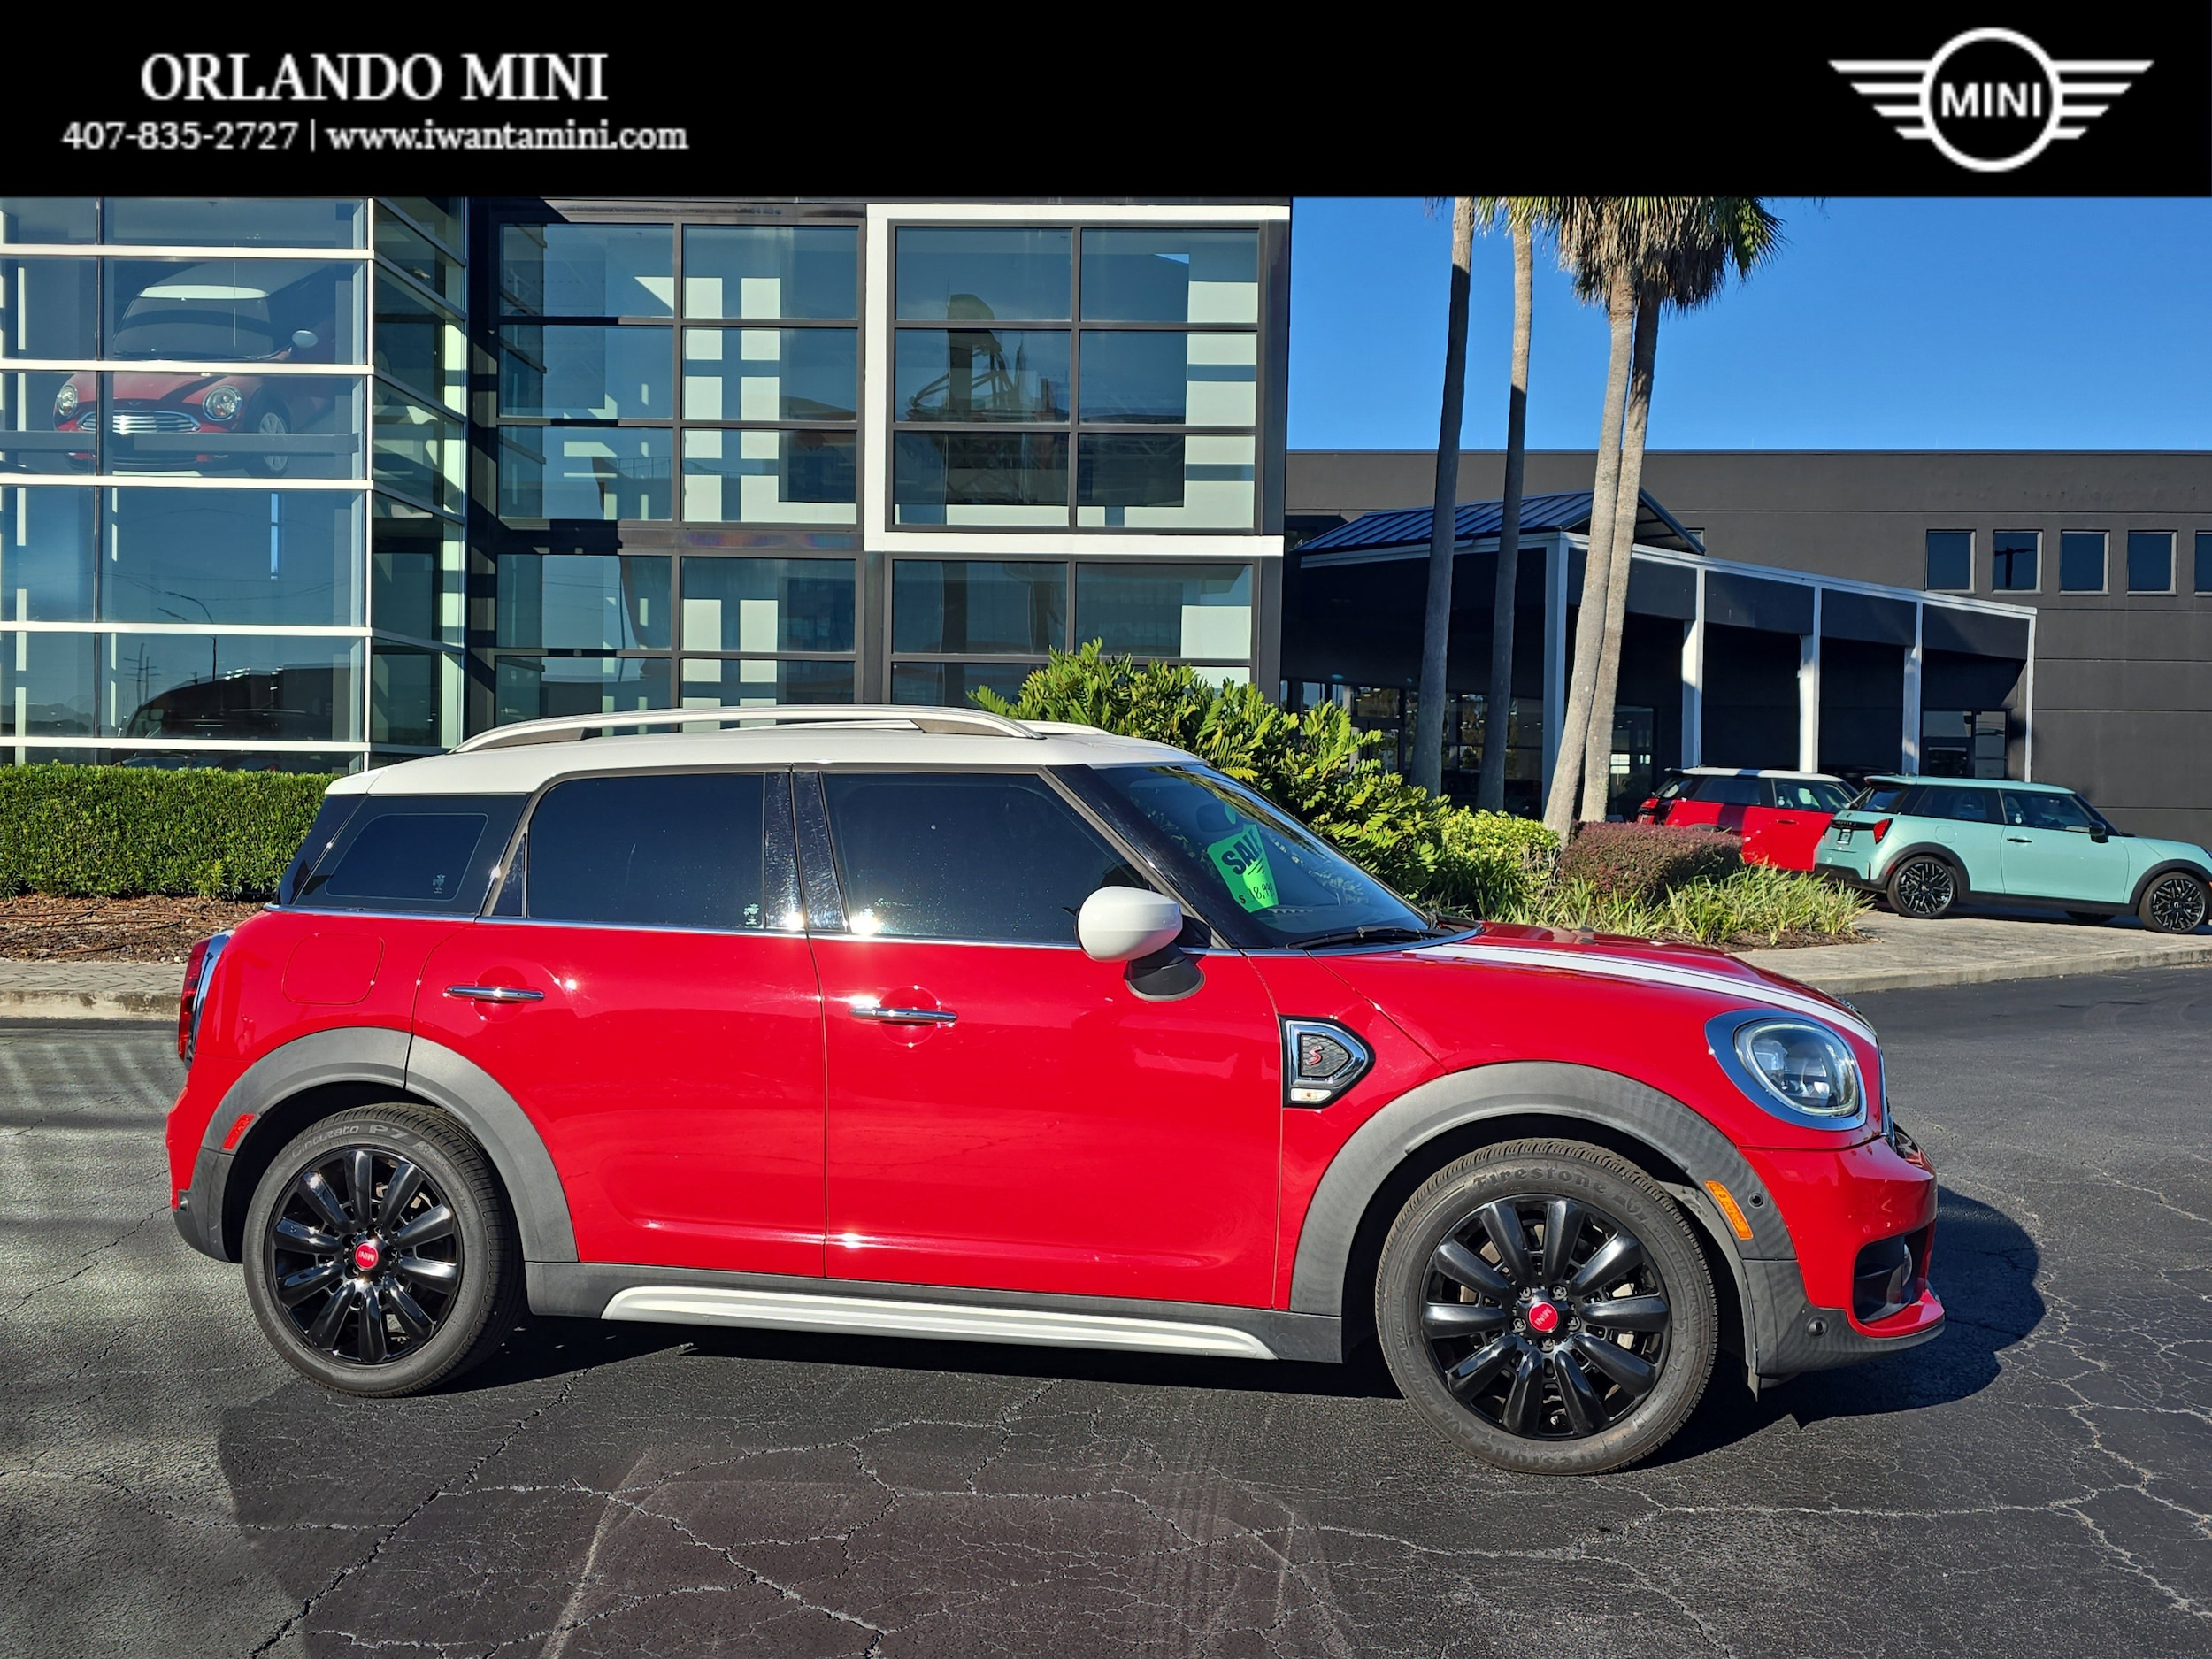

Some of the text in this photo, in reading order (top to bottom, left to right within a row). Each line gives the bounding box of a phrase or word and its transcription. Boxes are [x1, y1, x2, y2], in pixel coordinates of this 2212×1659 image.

[1306, 1045, 1325, 1066] S
[368, 1124, 410, 1140] P7
[1472, 1166, 1609, 1194] Firestone
[357, 1250, 376, 1263] MINI
[1533, 1306, 1553, 1327] MINI
